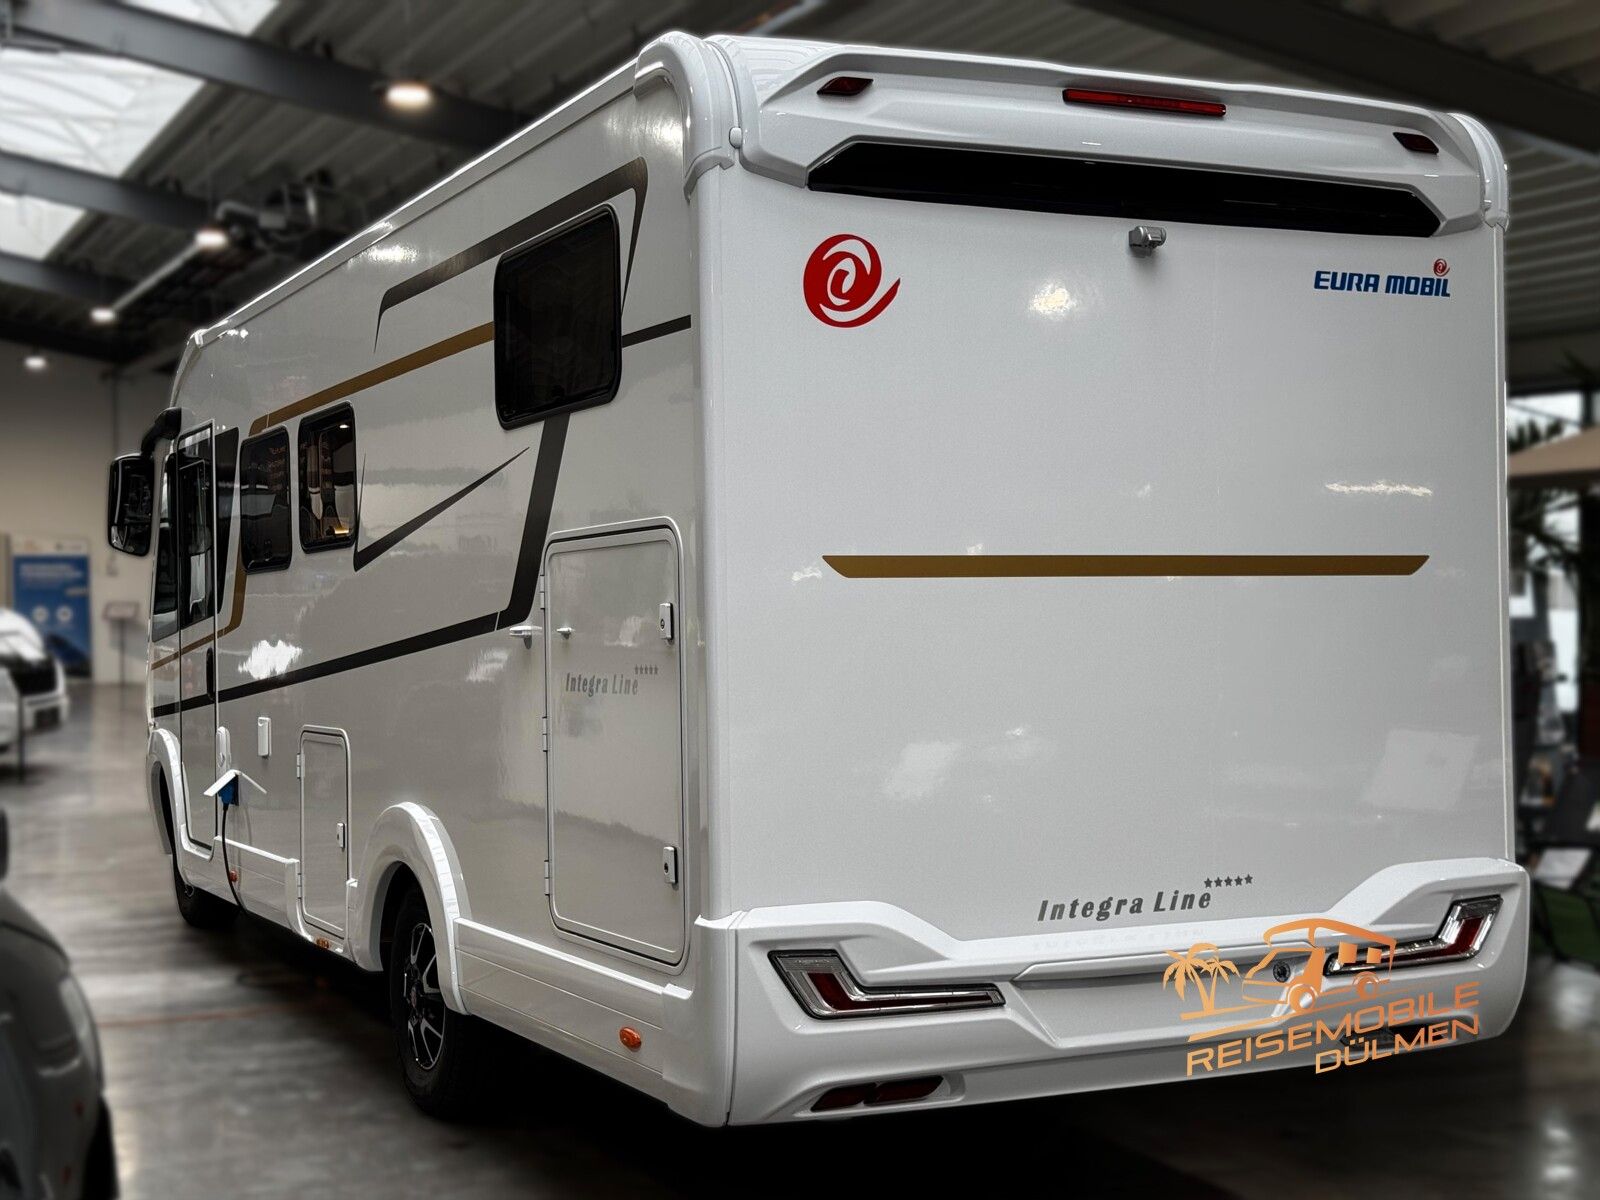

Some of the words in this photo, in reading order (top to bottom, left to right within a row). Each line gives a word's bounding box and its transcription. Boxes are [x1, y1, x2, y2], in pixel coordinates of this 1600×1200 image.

[1314, 270, 1380, 293] EURA
[1385, 274, 1450, 297] MOBIL
[565, 672, 608, 697] Integra
[612, 674, 638, 695] Line
[1037, 896, 1144, 922] Integra
[1153, 889, 1212, 912] Line
